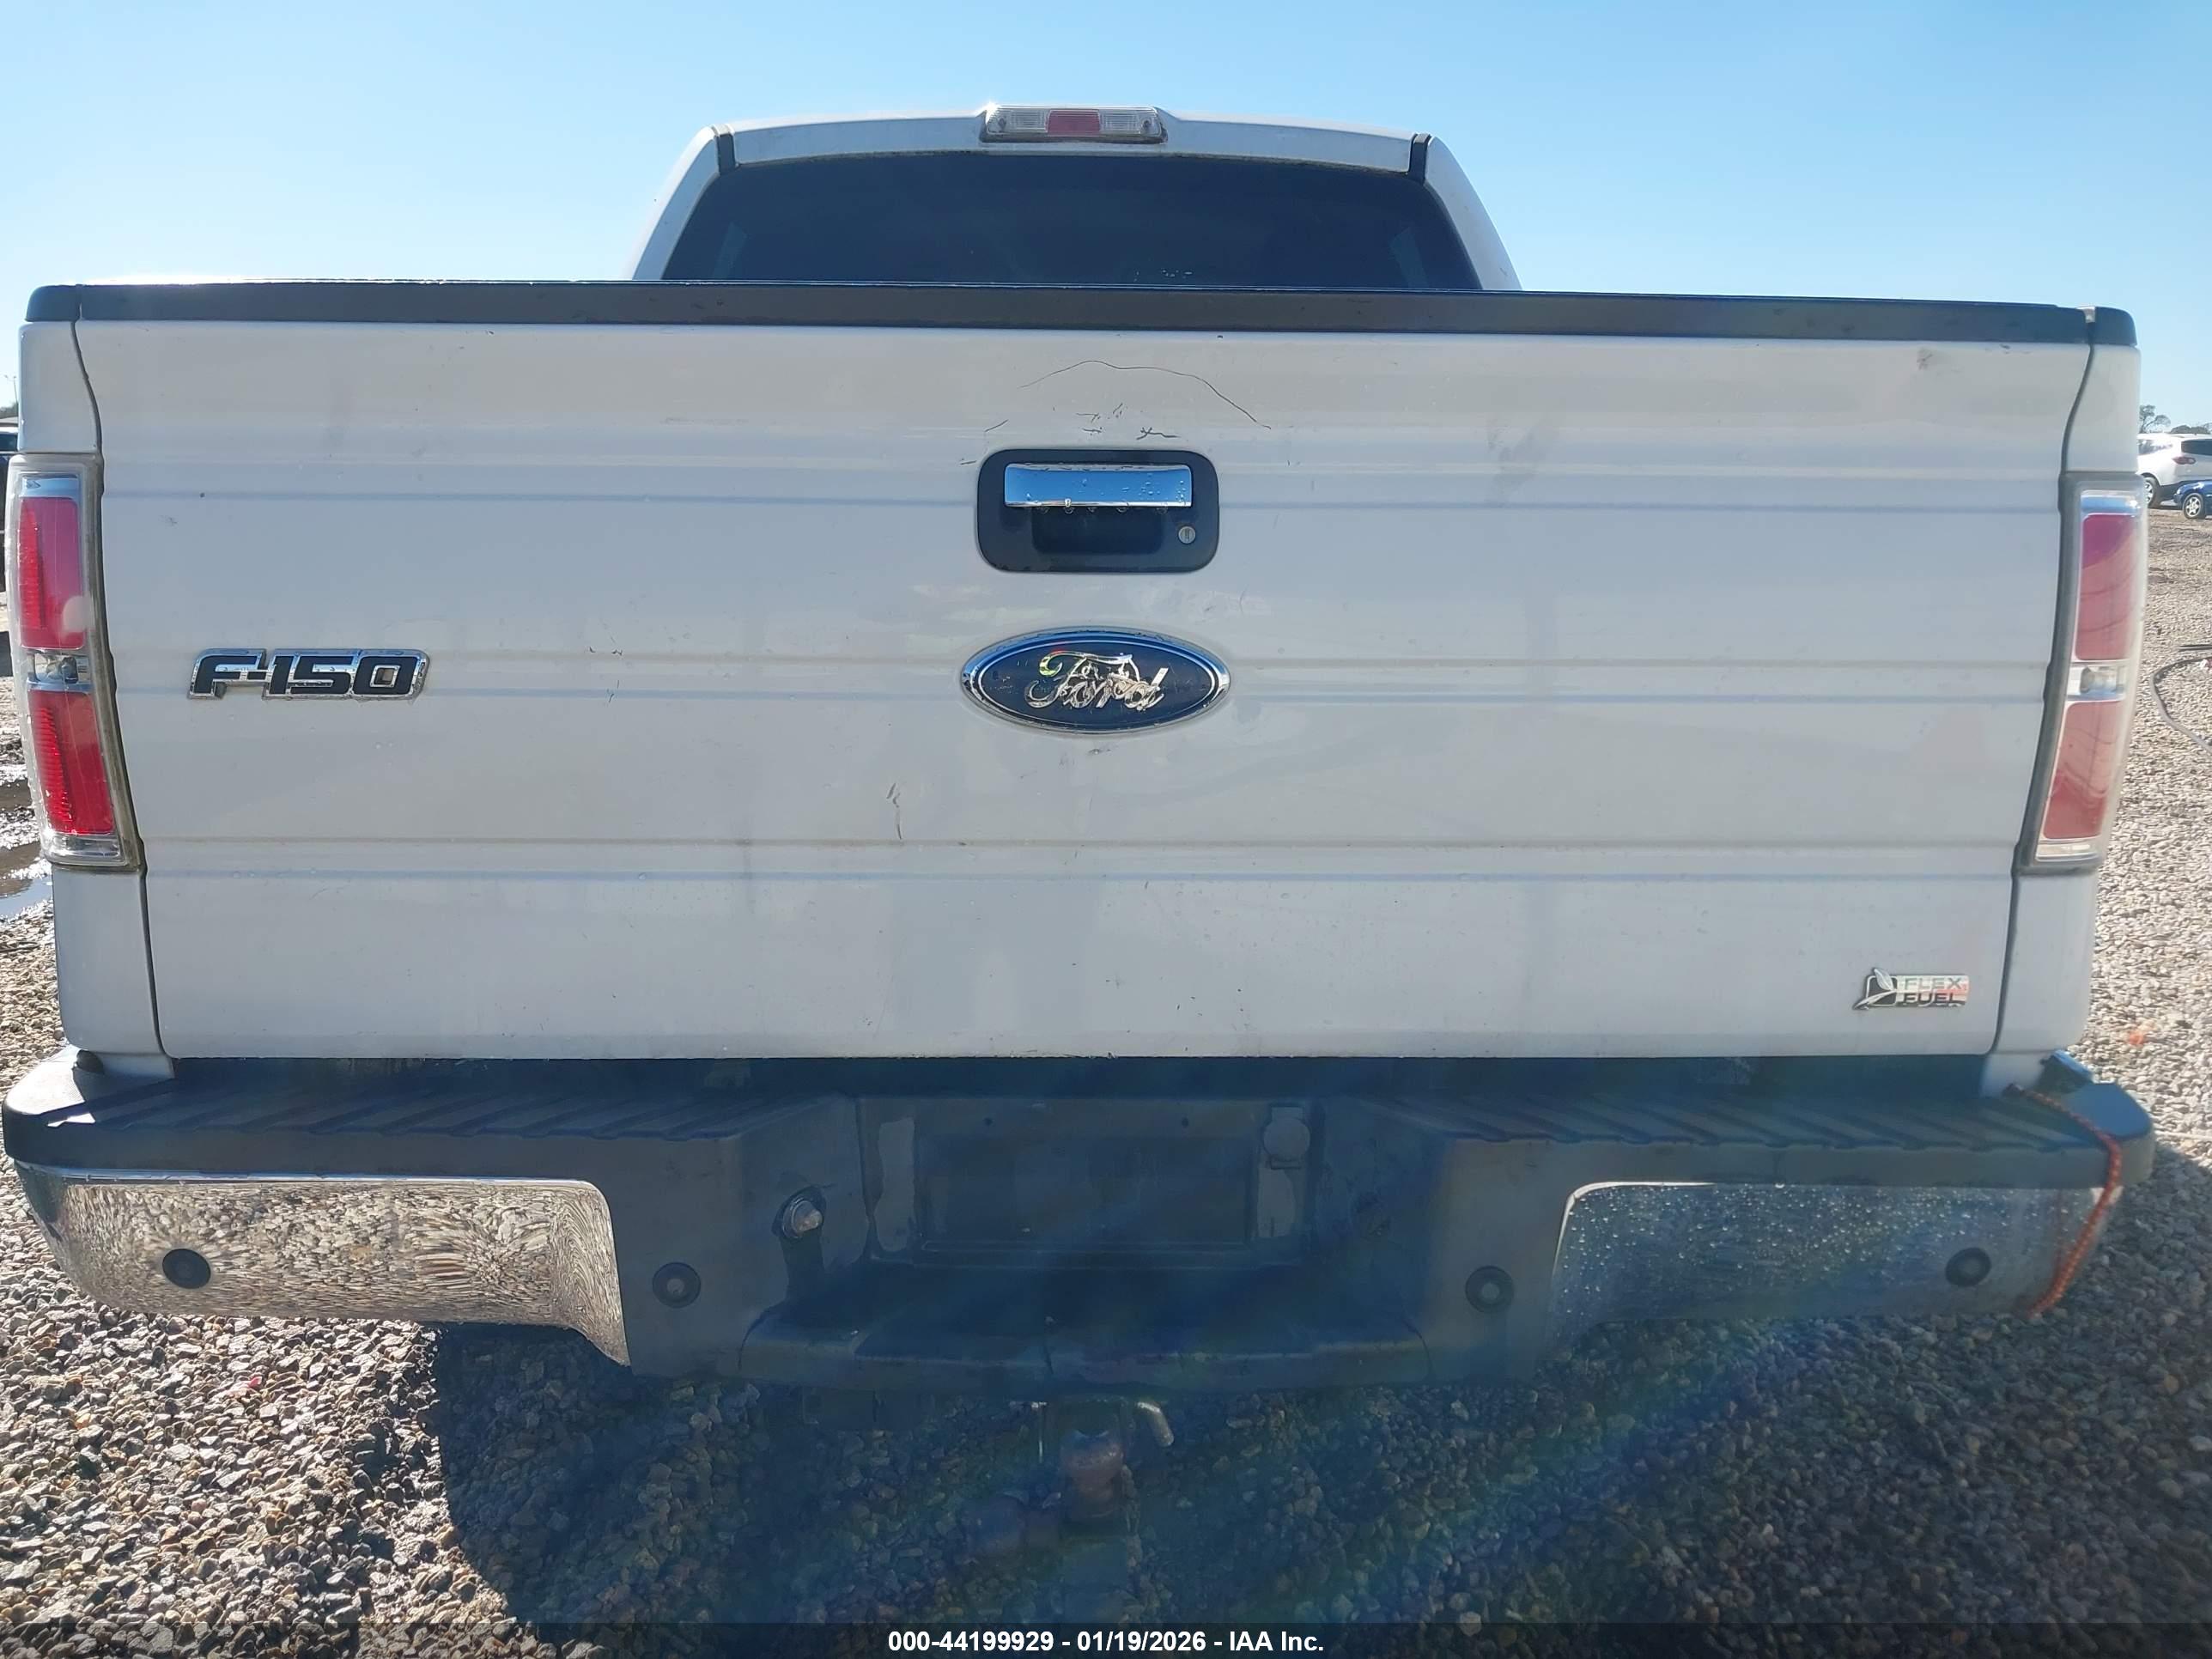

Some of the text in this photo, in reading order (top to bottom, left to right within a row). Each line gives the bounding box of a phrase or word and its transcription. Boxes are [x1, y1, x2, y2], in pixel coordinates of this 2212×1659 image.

[190, 649, 428, 699] F-150
[1028, 651, 1169, 709] Ford
[1902, 992, 1961, 1006] FUEL
[1903, 976, 1963, 991] FLEX
